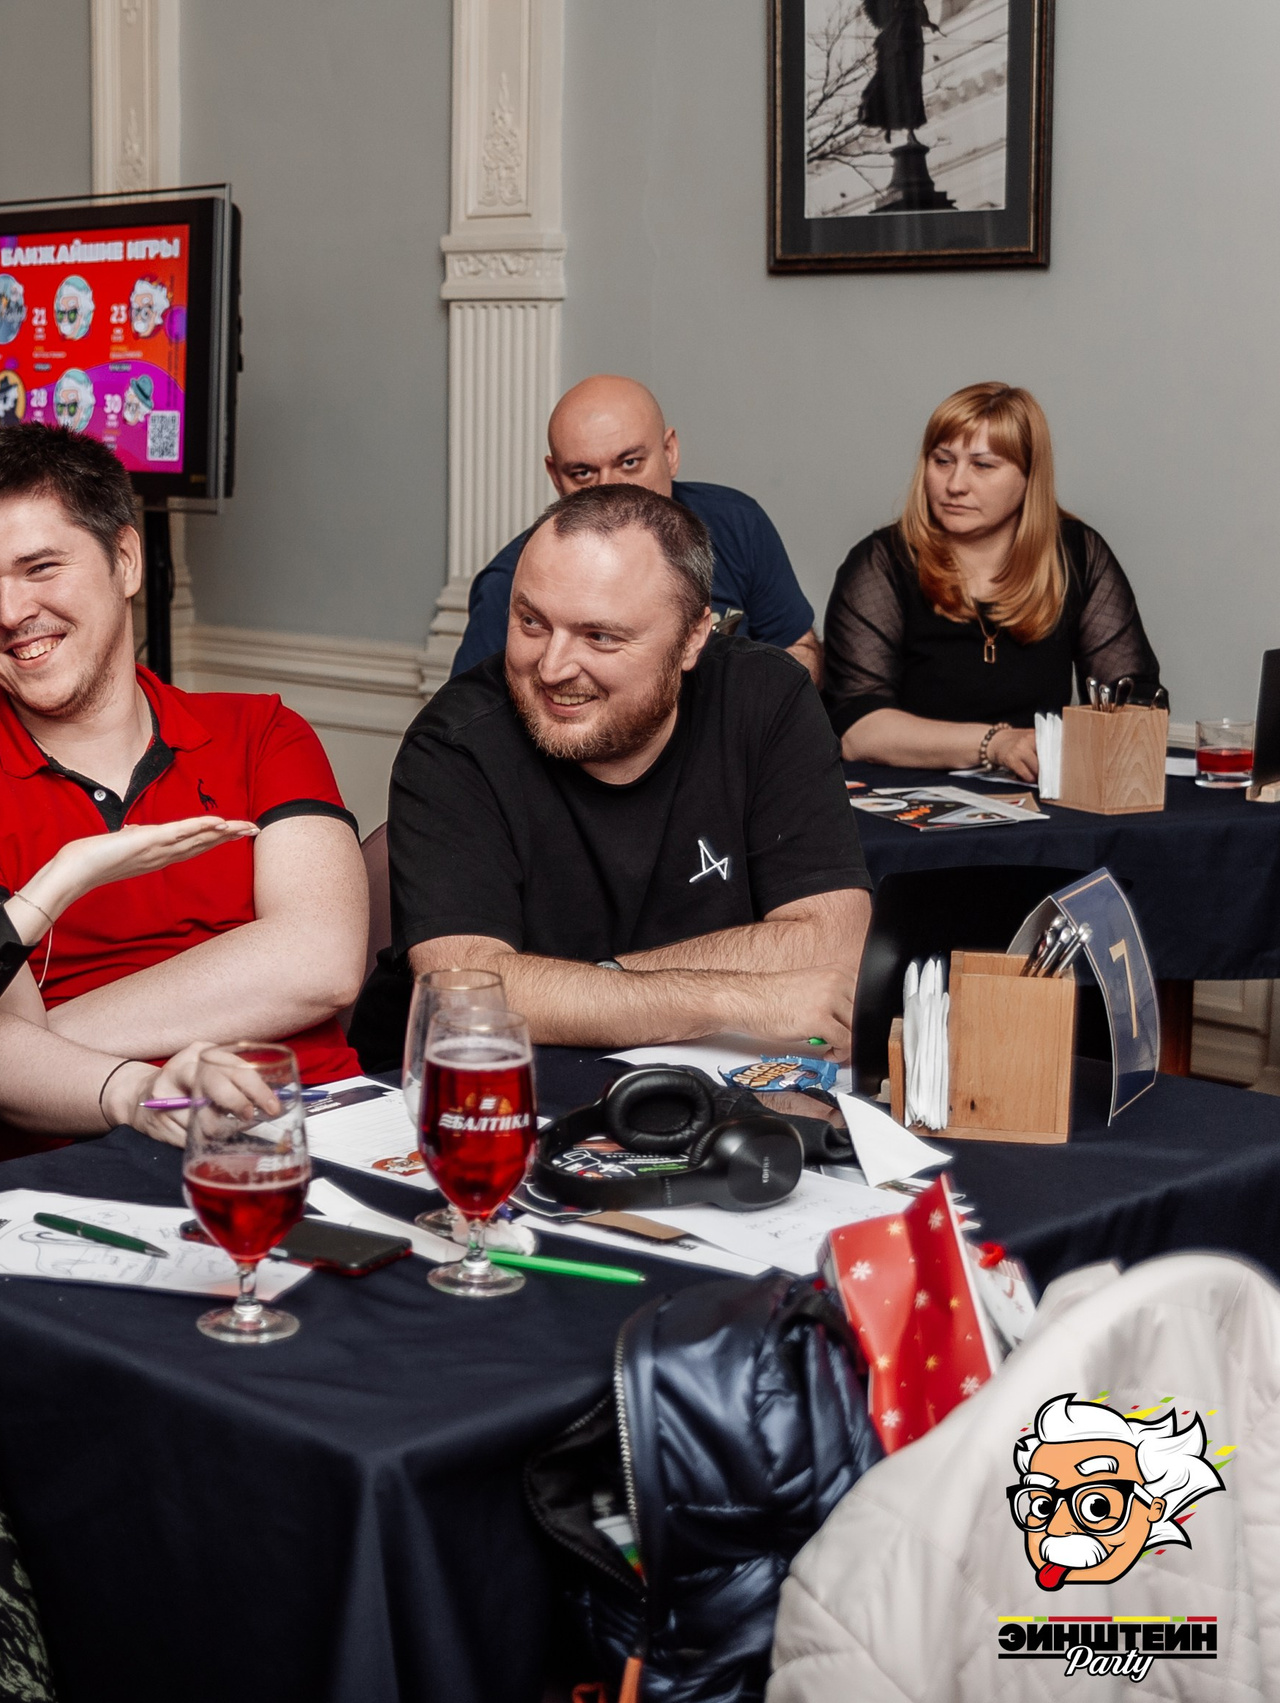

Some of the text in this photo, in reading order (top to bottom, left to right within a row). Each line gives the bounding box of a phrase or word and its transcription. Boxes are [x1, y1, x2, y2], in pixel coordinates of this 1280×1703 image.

[127, 238, 180, 260] ИГРЫ
[32, 307, 47, 326] 21
[110, 304, 128, 324] 23
[104, 394, 122, 414] 30
[445, 1113, 530, 1132] БАЛТИКА
